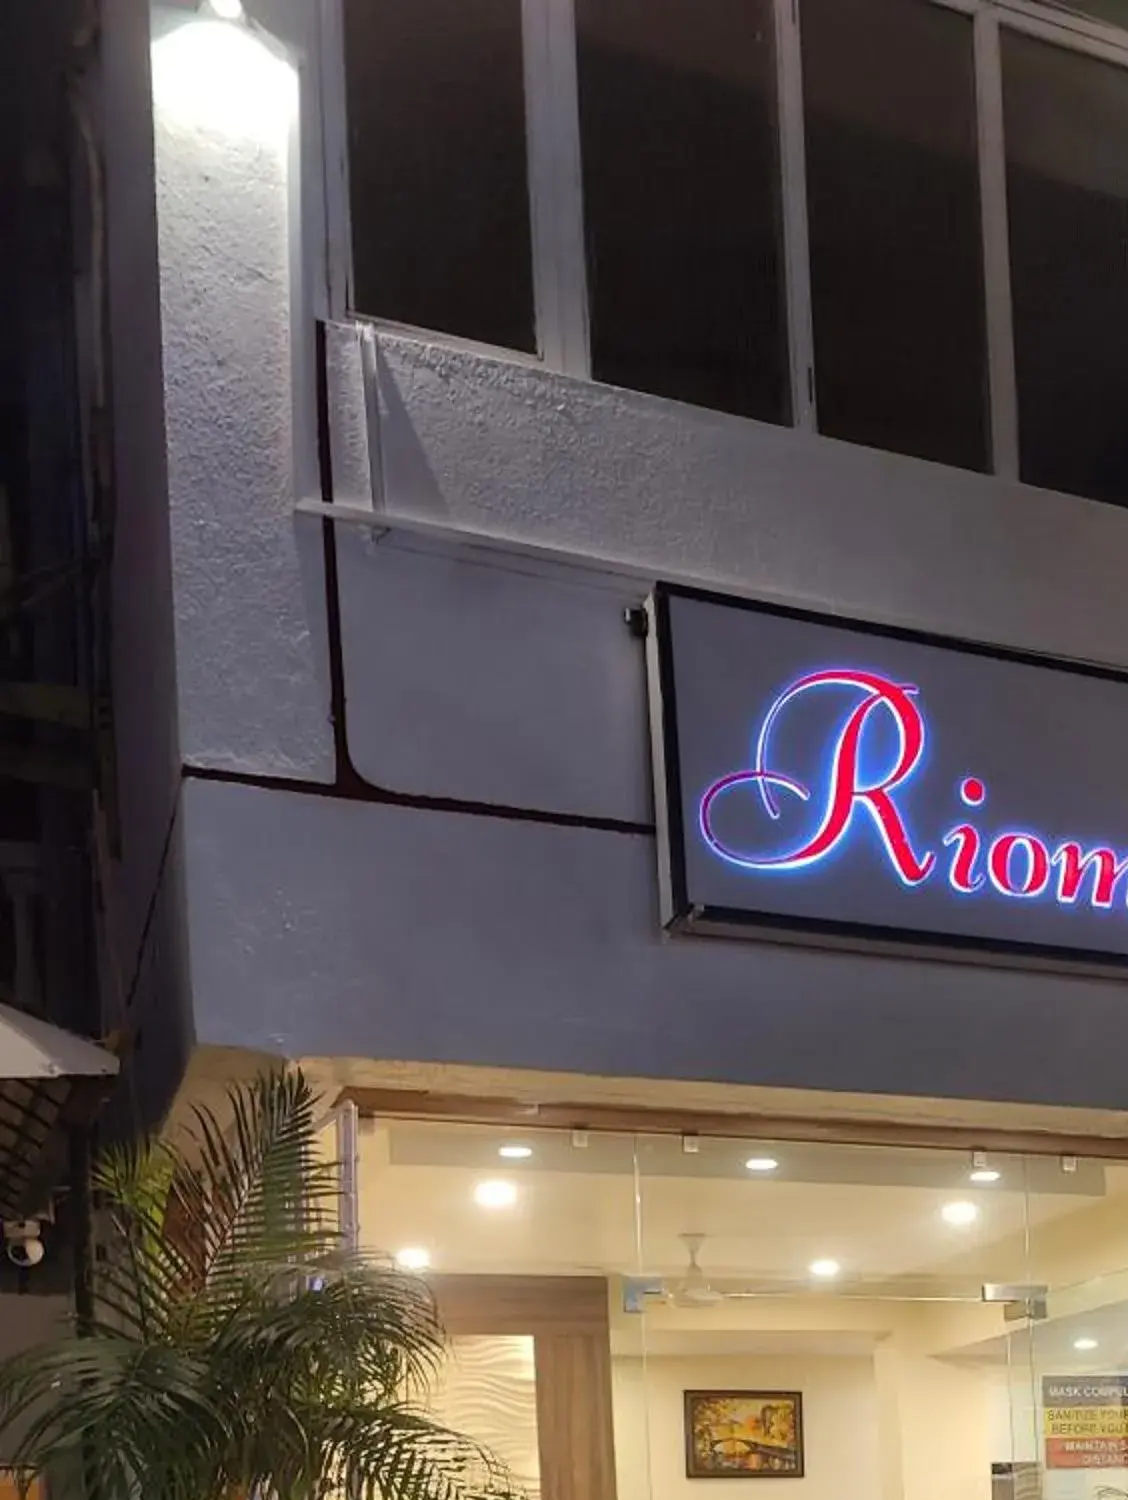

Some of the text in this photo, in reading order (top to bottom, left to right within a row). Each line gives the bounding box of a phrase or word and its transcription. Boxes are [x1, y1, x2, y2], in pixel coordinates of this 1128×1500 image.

[1049, 1385, 1081, 1397] MASK
[1051, 1422, 1097, 1434] BEFORE
[1100, 1422, 1123, 1433] YOU
